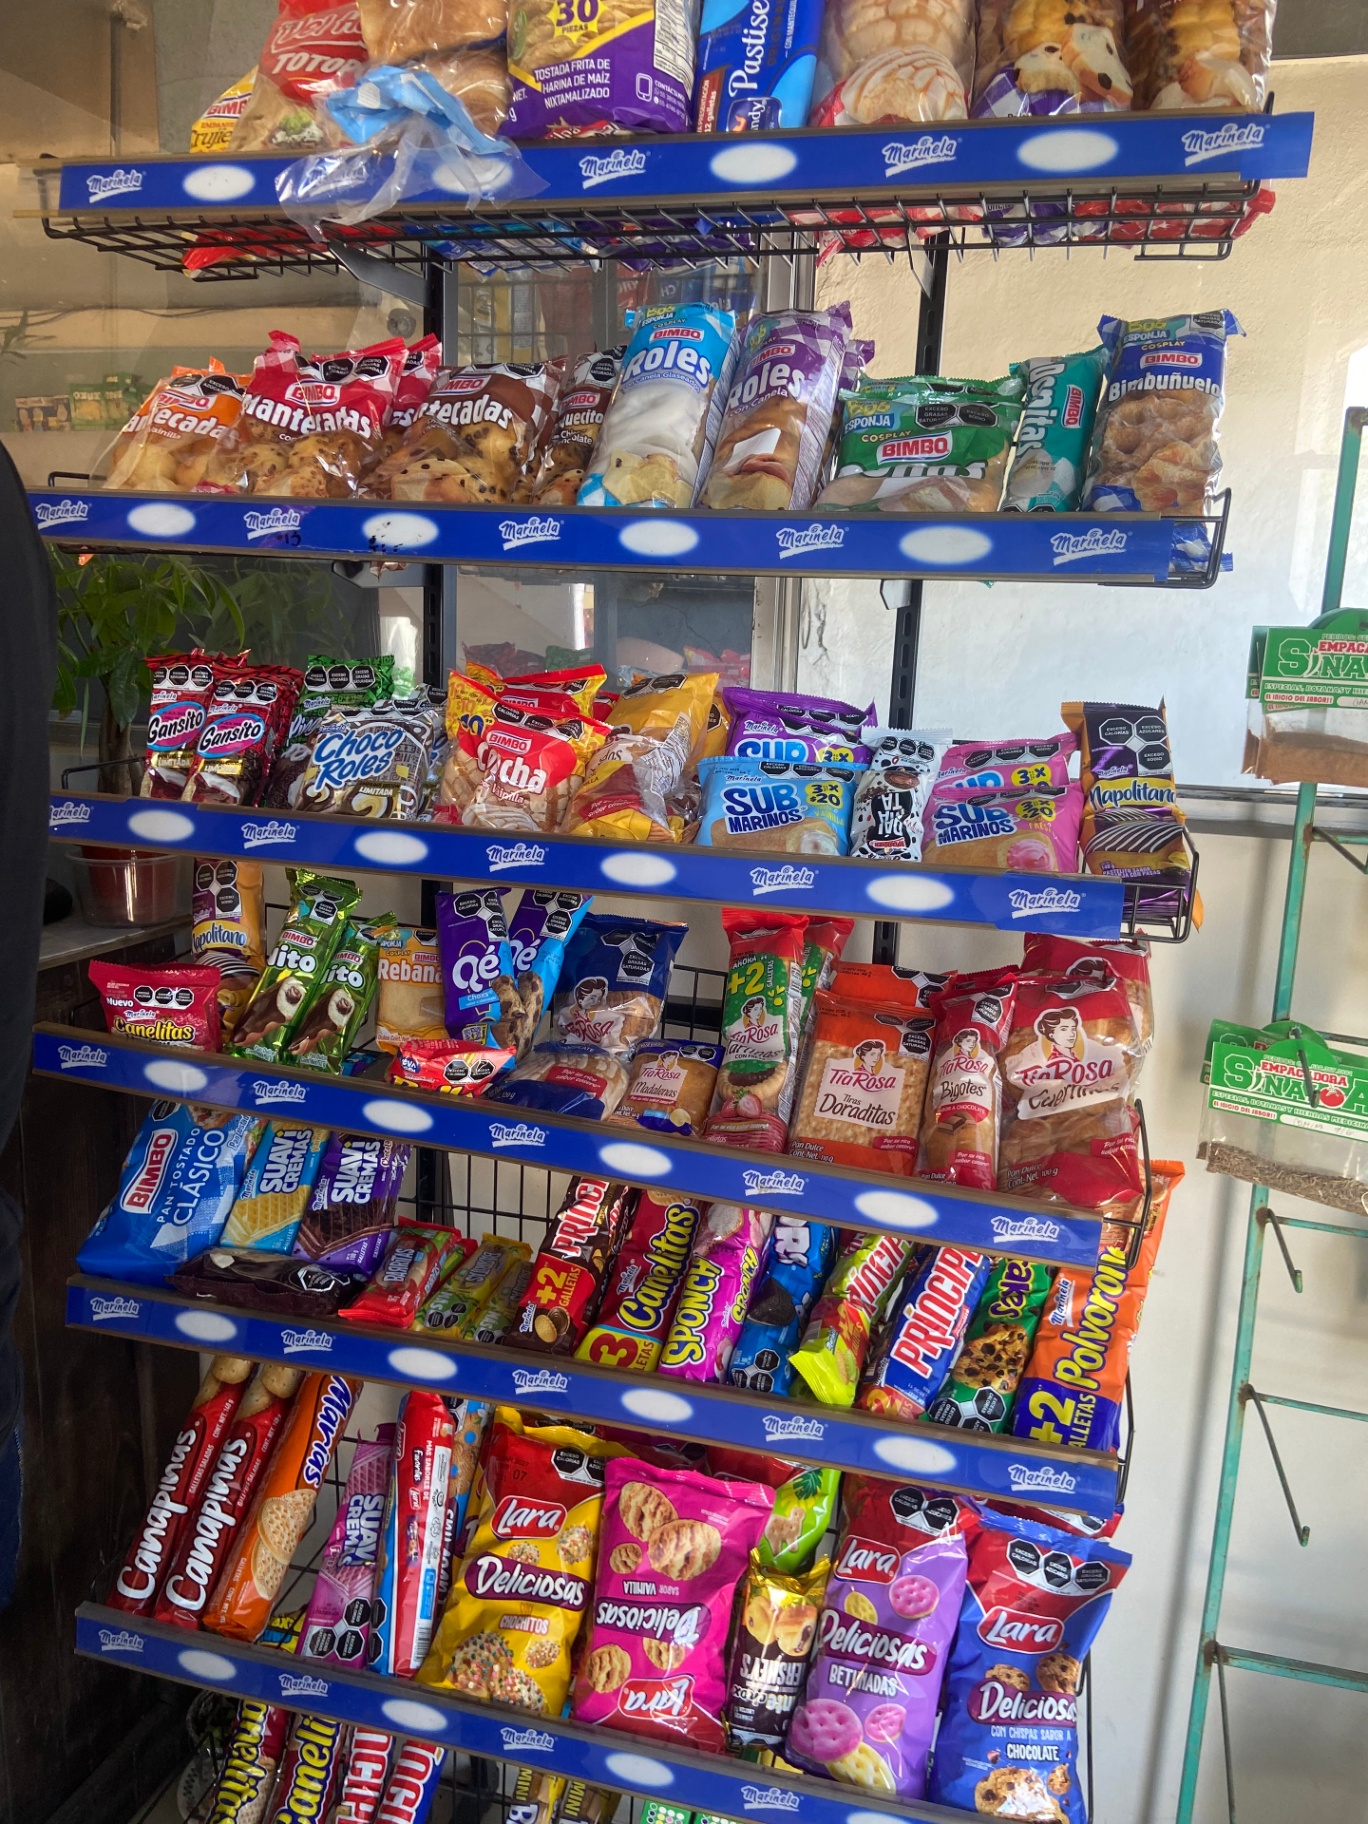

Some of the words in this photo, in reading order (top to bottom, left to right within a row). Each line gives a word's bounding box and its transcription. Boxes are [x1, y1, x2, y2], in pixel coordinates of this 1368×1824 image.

[556, 0, 599, 26] 30
[561, 23, 589, 34] PIEZAS
[272, 52, 364, 74] TOTOP
[534, 64, 571, 81] TOSTADA
[571, 60, 595, 75] FRITA
[597, 59, 610, 69] DE
[542, 78, 573, 94] HARINA
[573, 77, 586, 87] DE
[588, 70, 610, 84] MAÍZ
[544, 87, 610, 109] NIXTAMALIZADO
[1182, 123, 1265, 153] Marinela
[882, 136, 956, 166] Marinela
[579, 150, 646, 178] Marinela
[87, 169, 143, 194] Marinela
[654, 329, 701, 340] BIMBO
[1123, 331, 1167, 343] ESPONJA
[1141, 341, 1186, 351] COSPLAY
[622, 341, 710, 385] Roles
[1144, 354, 1199, 364] BIMBO
[293, 386, 336, 400] BIMBO
[729, 364, 805, 408] Roles
[1064, 387, 1082, 427] BIMBO
[845, 414, 891, 434] ESPONJA
[862, 430, 911, 443] COSPLAY
[882, 437, 948, 458] BIMBO
[36, 500, 88, 520] Marinela
[244, 508, 301, 529] Marinela
[499, 517, 559, 541] Marinela
[775, 523, 843, 547] Marinela
[1050, 528, 1127, 552] Marinela
[148, 709, 204, 743] Gansito
[199, 721, 262, 752] Gansito
[314, 728, 403, 764] Choco
[488, 734, 528, 751] BIMBO
[315, 750, 394, 792] Roles
[358, 787, 394, 797] LIMITADA
[724, 784, 800, 816] SUB
[242, 822, 297, 842] Marinela
[728, 809, 802, 834] MARINOS
[938, 820, 1014, 844] MARINOS
[486, 844, 545, 865] Marinela
[750, 865, 814, 888] Marinela
[1009, 887, 1080, 910] Marinela
[281, 931, 315, 946] BIMBO
[732, 956, 757, 968] AHORA
[727, 961, 766, 996] +2
[106, 997, 134, 1008] Nuevo
[114, 1016, 195, 1042] Canelitas
[58, 1045, 107, 1063] Marinela
[955, 1056, 988, 1074] Rosa
[830, 1067, 853, 1086] Tía
[851, 1069, 897, 1092] Rosa
[1046, 1060, 1113, 1085] Rosa
[1261, 1061, 1348, 1087] EMPACDORA
[254, 1081, 307, 1101] Marinela
[633, 1081, 677, 1097] Madalenas
[842, 1094, 862, 1105] Tiras
[941, 1079, 986, 1102] Bigotes
[819, 1093, 897, 1125] Doraditas
[489, 1124, 547, 1145] Marinela
[792, 1141, 804, 1149] Pan
[805, 1142, 824, 1152] Dulce
[127, 1133, 173, 1208] BIMBO
[281, 1127, 313, 1194] CREMAS
[354, 1141, 381, 1204] CREMAS
[1007, 1169, 1020, 1178] Pan
[1021, 1163, 1041, 1175] Dulce
[156, 1197, 175, 1223] PAN
[170, 1128, 201, 1187] TOSTADO
[173, 1130, 225, 1225] CLÁSICO
[240, 1168, 257, 1200] Marinela
[743, 1170, 805, 1190] Marinela
[1008, 1178, 1024, 1189] Cont.
[1026, 1173, 1039, 1182] Net.
[312, 1177, 330, 1211] Marinela
[991, 1216, 1060, 1239] Marinela
[357, 1238, 369, 1264] GALLETAS
[618, 1206, 698, 1328] Canelitas
[618, 1264, 638, 1293] Marinela
[536, 1266, 568, 1305] +2
[561, 1267, 581, 1307] GALLETAS
[732, 1248, 759, 1323] SPONCH
[90, 1297, 140, 1316] Marinela
[663, 1256, 722, 1366] SPONCH
[1050, 1278, 1070, 1327] Marinela
[519, 1304, 536, 1332] Marinela
[281, 1330, 333, 1349] Marinela
[512, 1369, 569, 1390] Marinela
[764, 1415, 824, 1436] Marinela
[1029, 1391, 1076, 1445] +2
[556, 1455, 582, 1466] CALORÍAS
[559, 1450, 581, 1460] EXCESO
[423, 1455, 432, 1487] SABORES
[1010, 1464, 1076, 1489] Marinela
[116, 1428, 197, 1600] Canapinas
[165, 1438, 248, 1611] Canapinas
[499, 1499, 558, 1536] Lara
[838, 1539, 895, 1576] Lara
[1014, 1547, 1036, 1559] EXCESO
[477, 1556, 585, 1607] Deliciosas
[623, 1581, 656, 1595] VAINILLA
[659, 1584, 680, 1595] SABOR
[500, 1615, 550, 1635] CHOCHITOS
[596, 1601, 702, 1647] Deliciosas
[985, 1611, 1055, 1644] Lara
[99, 1631, 144, 1651] Marinela
[820, 1610, 928, 1670] Deliciosas
[279, 1674, 329, 1696] Marinela
[625, 1681, 688, 1716] Lara
[501, 1728, 555, 1751] Marinela
[991, 1726, 1006, 1738] CON
[1008, 1726, 1038, 1741] CHISPAS
[1040, 1729, 1064, 1741] SABOR
[1066, 1731, 1072, 1741] A
[1006, 1743, 1060, 1762] CHOCOLATE
[564, 1780, 585, 1817] MINI
[741, 1785, 799, 1808] Marinela
